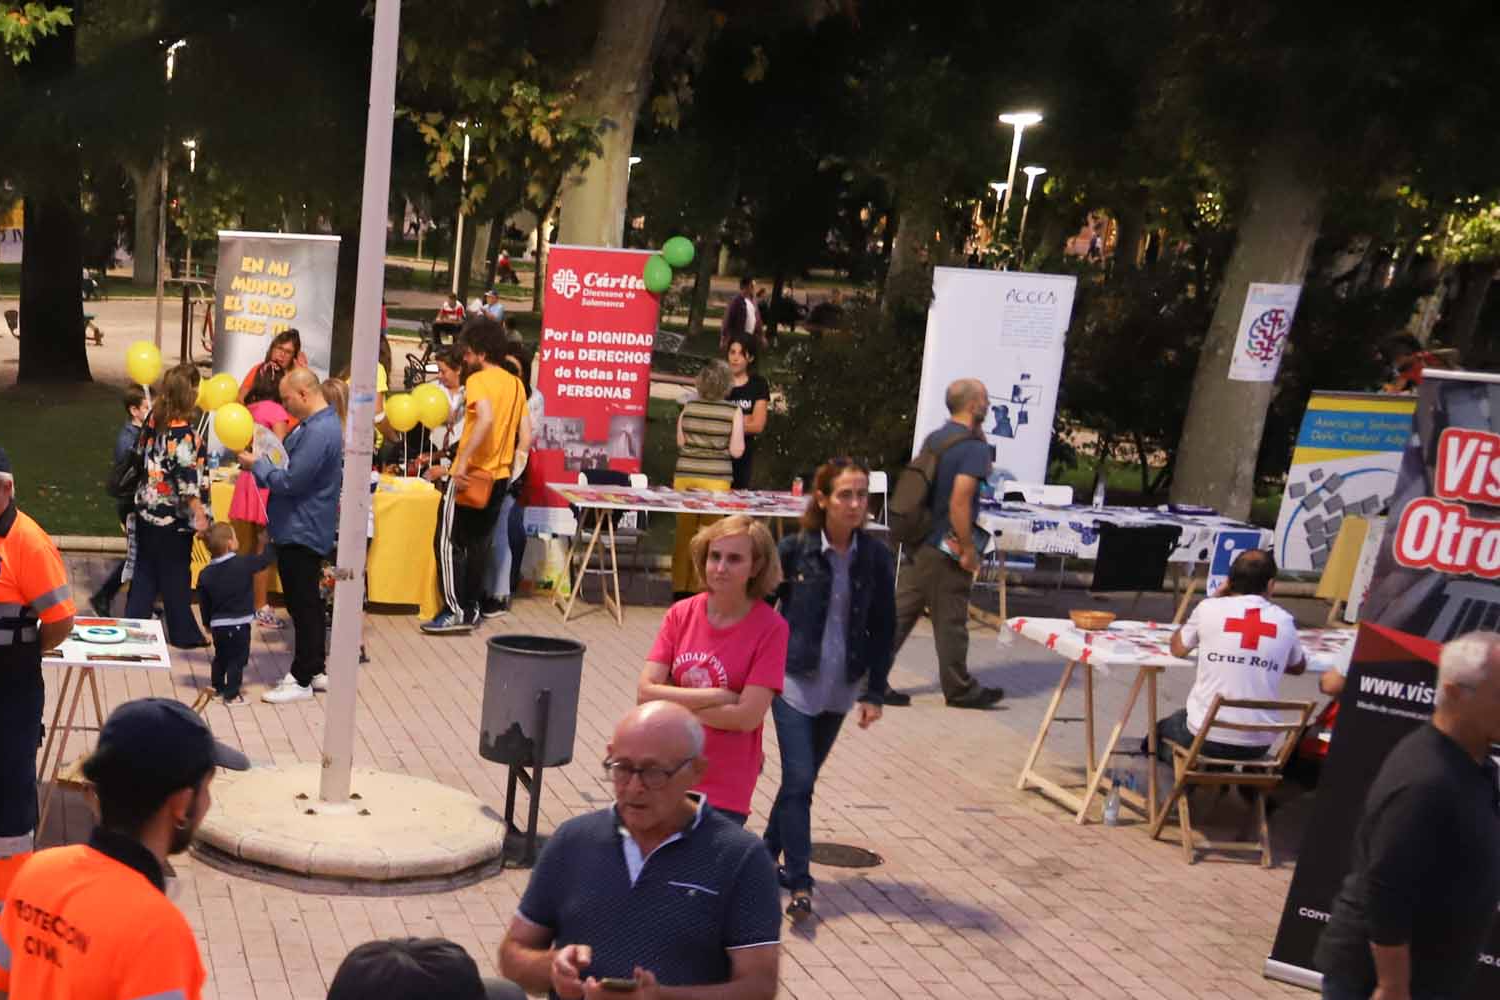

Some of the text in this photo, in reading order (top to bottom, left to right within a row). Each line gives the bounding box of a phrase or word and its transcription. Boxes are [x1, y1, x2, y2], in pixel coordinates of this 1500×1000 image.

[241, 255, 265, 273] EN
[544, 328, 654, 347] Por la DIGNIDAD
[542, 347, 652, 365] y los DERECHOS
[554, 366, 638, 382] de todas las
[557, 383, 632, 400] PERSONAS
[1207, 652, 1279, 672] Cruz Roja
